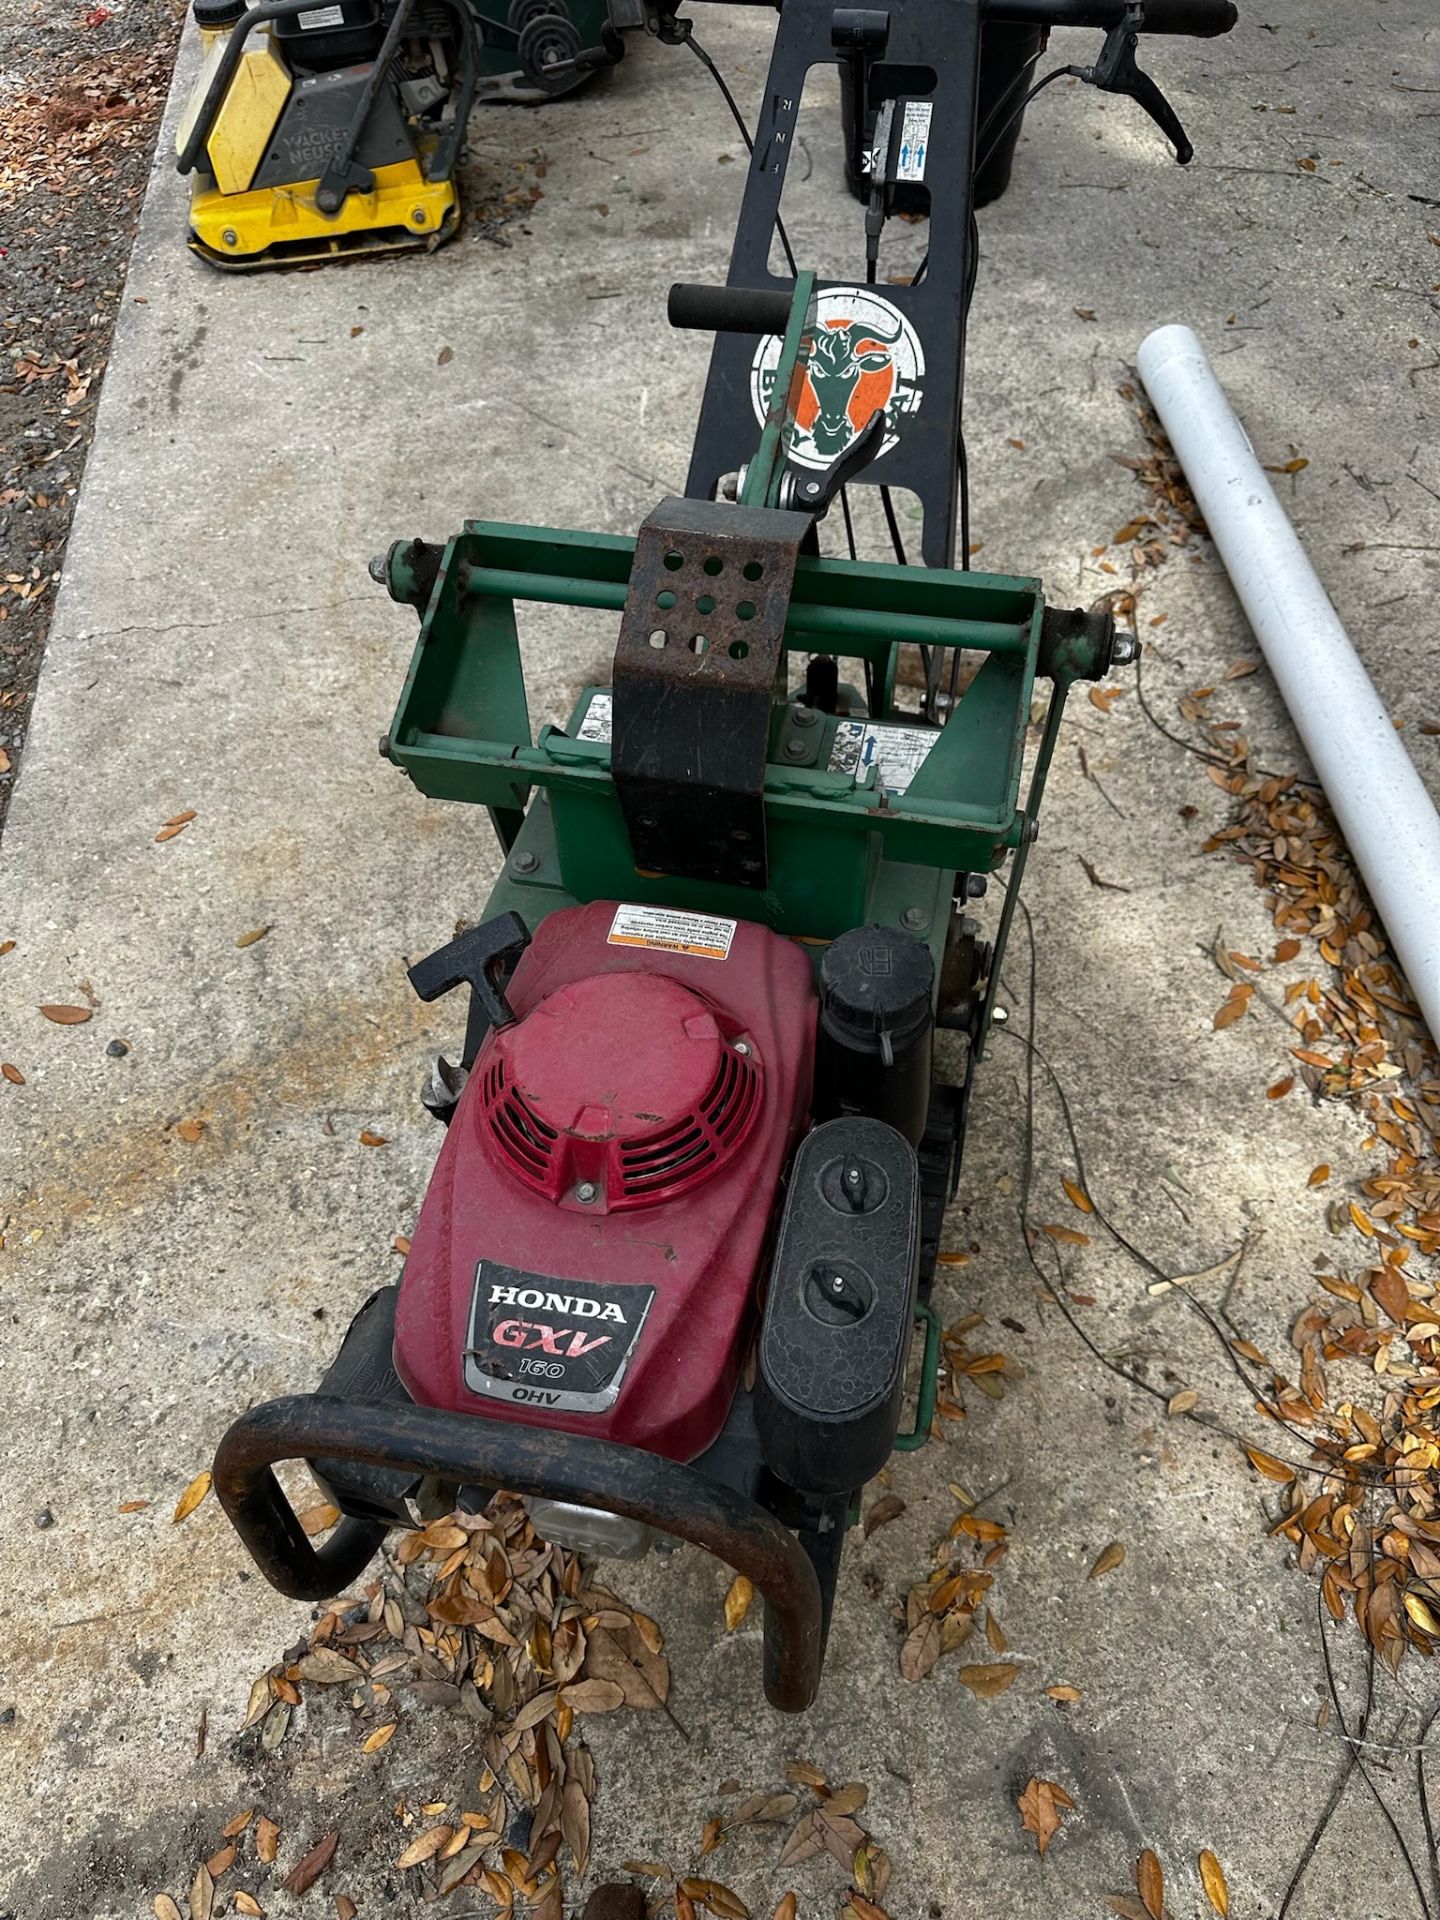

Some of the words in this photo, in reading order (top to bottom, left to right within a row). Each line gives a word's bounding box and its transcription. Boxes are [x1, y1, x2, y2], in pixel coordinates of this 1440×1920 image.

[783, 99, 792, 111] R
[775, 132, 786, 144] N
[646, 940, 679, 950] WARNING
[488, 1285, 627, 1324] HONDA
[492, 1319, 612, 1358] GXV
[519, 1358, 565, 1378] 160
[512, 1388, 562, 1405] OHV
